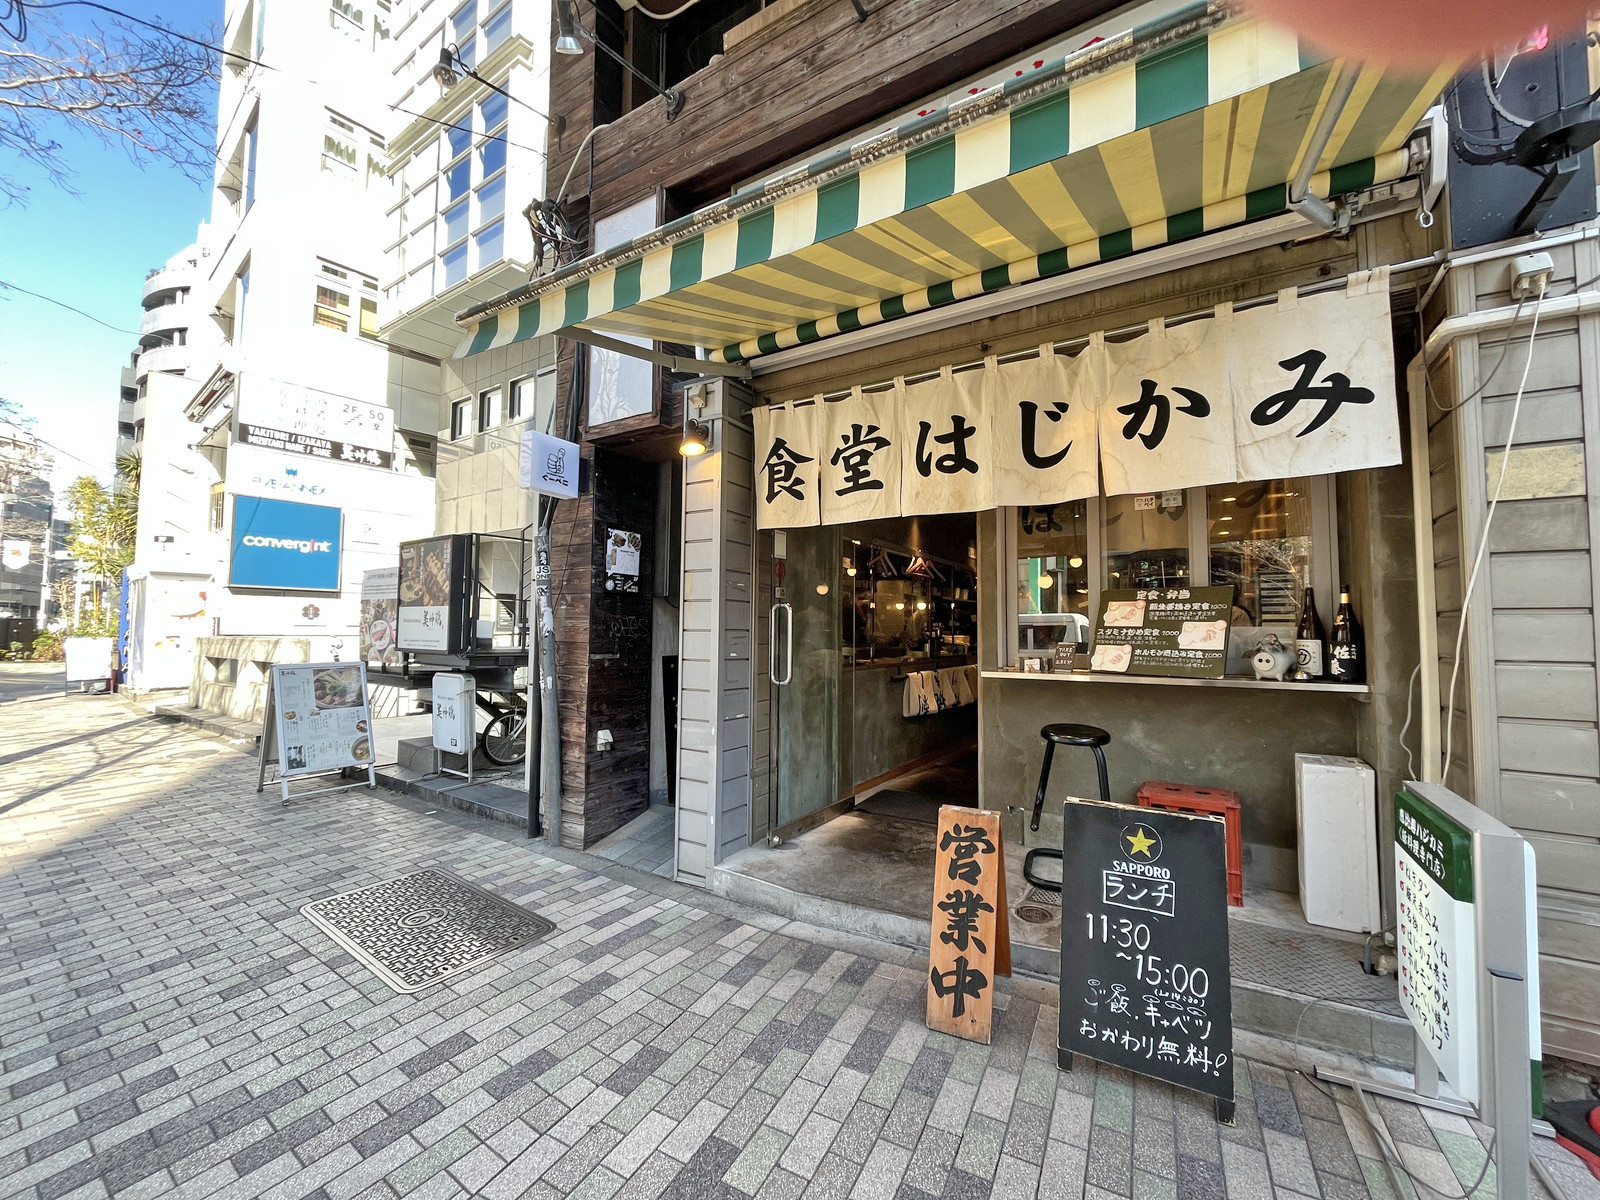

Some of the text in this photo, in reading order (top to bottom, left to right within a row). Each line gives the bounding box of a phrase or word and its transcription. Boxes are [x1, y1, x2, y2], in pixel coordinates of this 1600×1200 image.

[760, 349, 1375, 504] 食堂はじかみ
[243, 535, 332, 553] convergint
[1112, 860, 1171, 880] SAPPORO
[1106, 875, 1174, 907] ランチ
[930, 822, 996, 1018] 営業中
[1086, 912, 1151, 951] 11:30
